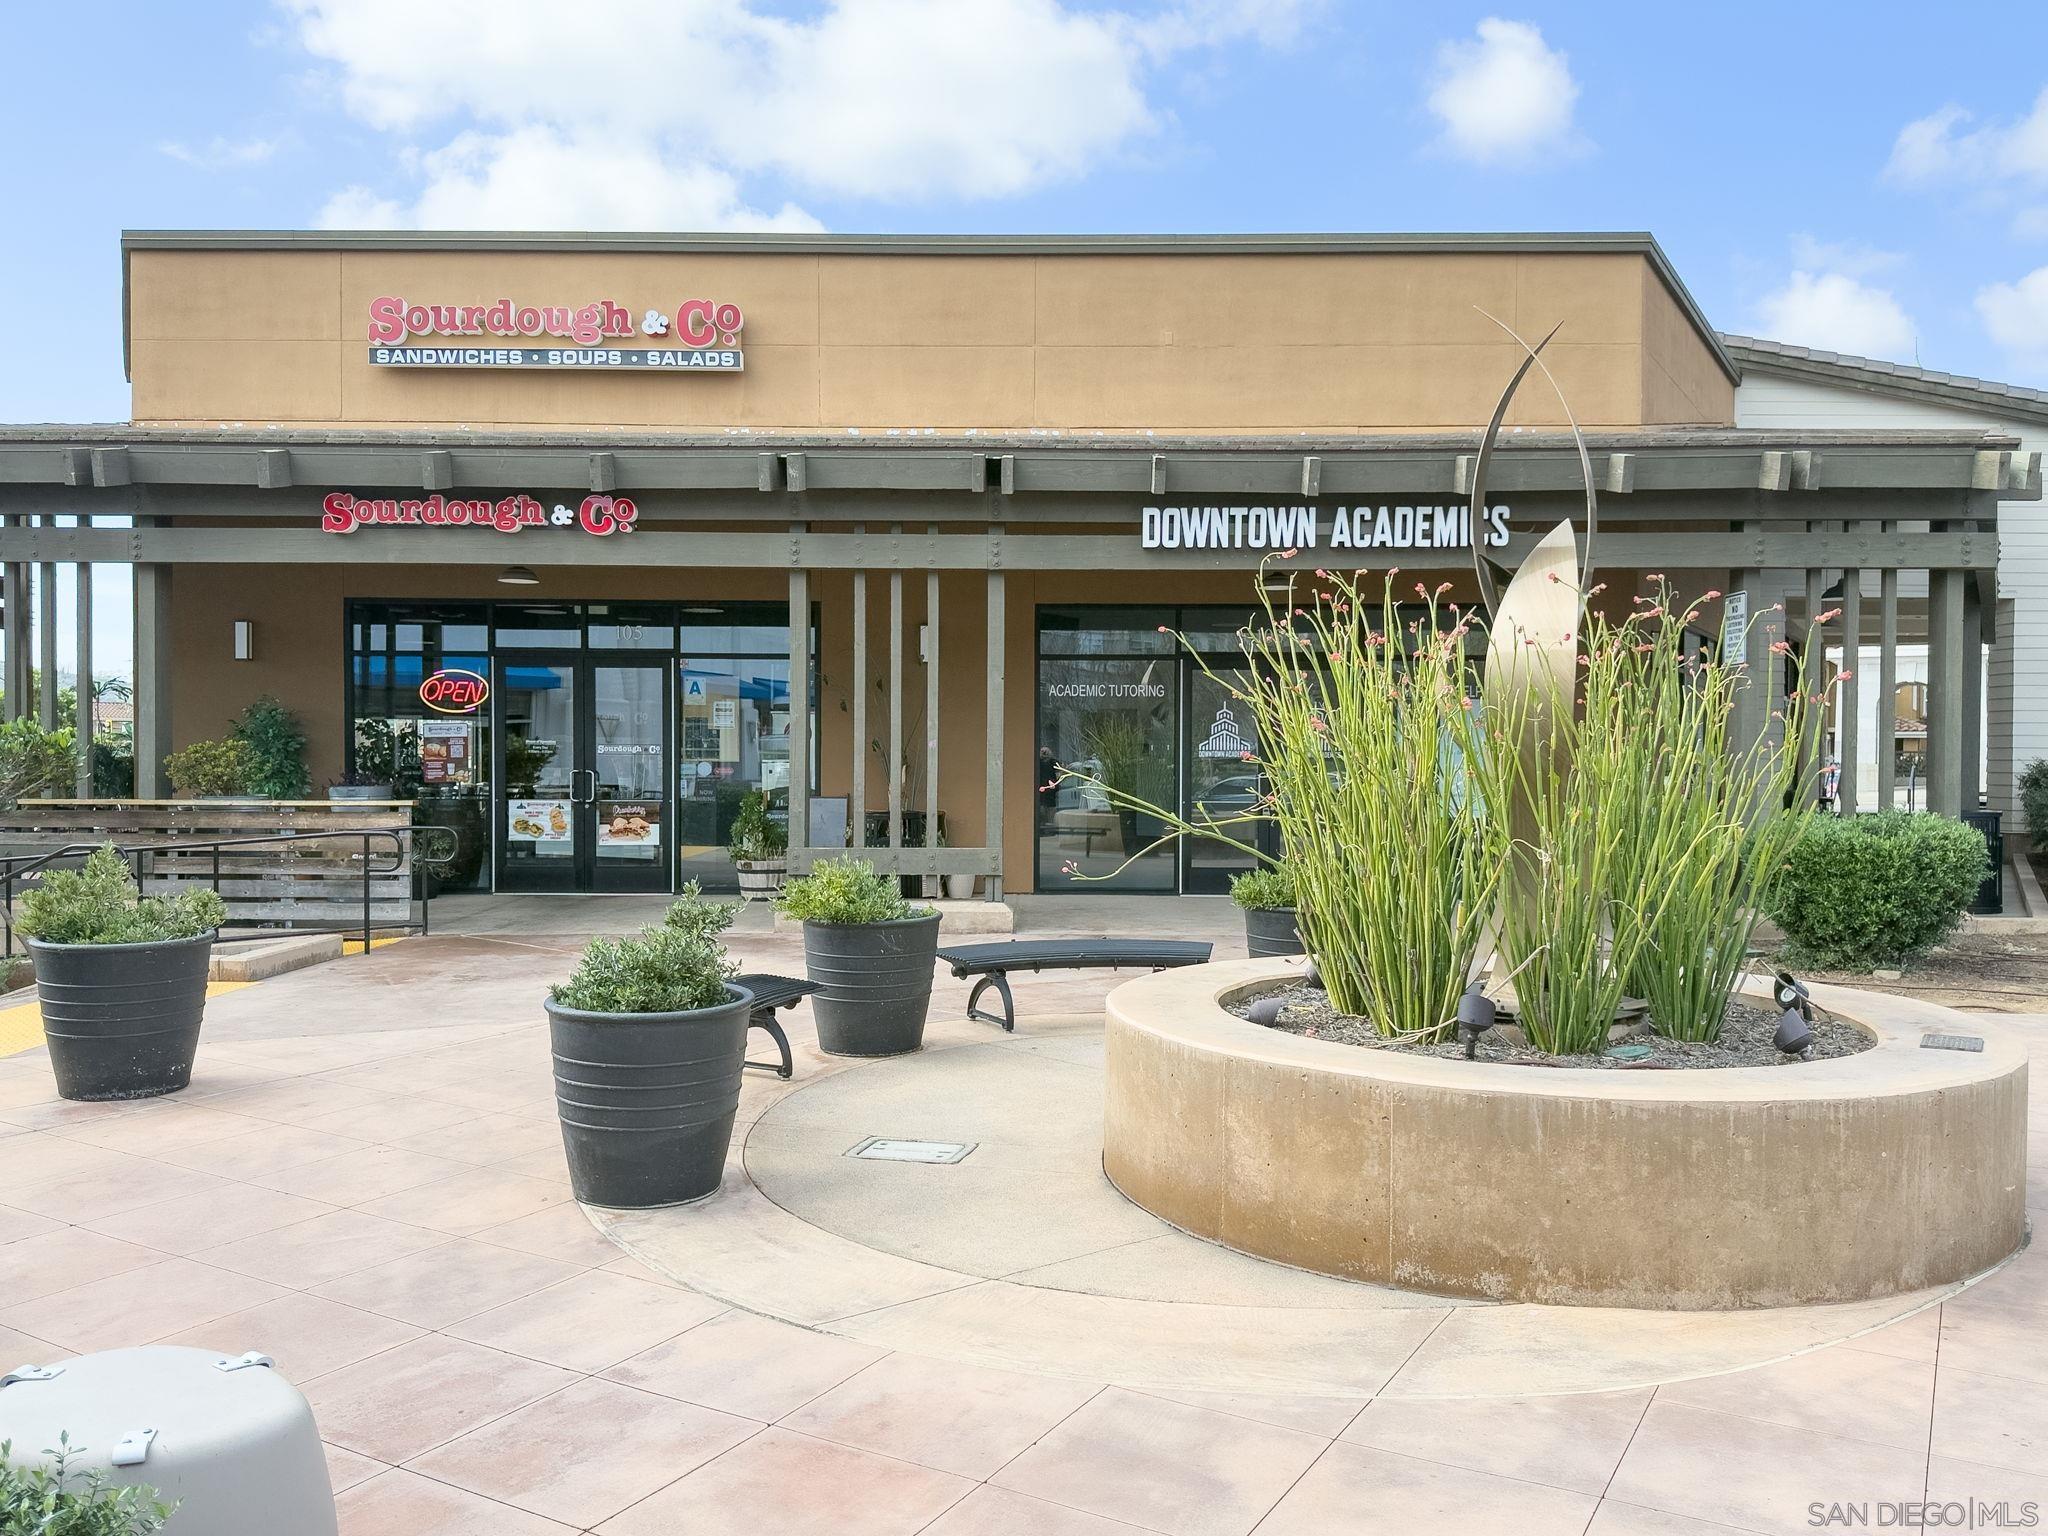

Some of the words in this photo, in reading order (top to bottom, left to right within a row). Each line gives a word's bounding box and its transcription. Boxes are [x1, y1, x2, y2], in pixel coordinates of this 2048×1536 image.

[368, 298, 635, 346] Sourdough
[641, 310, 669, 336] &
[376, 350, 523, 364] SANDWICHES
[548, 351, 622, 365] SOUPS
[646, 351, 735, 366] SALADS
[322, 493, 548, 534] Sourdough
[551, 504, 574, 526] &
[1142, 507, 1316, 549] DOWNTOWN
[616, 625, 644, 641] 105
[424, 680, 484, 702] OPEN
[689, 681, 702, 695] A
[1048, 684, 1106, 697] ACADEMIC
[1108, 684, 1165, 697] TUTORING
[598, 745, 642, 754] Sourdough
